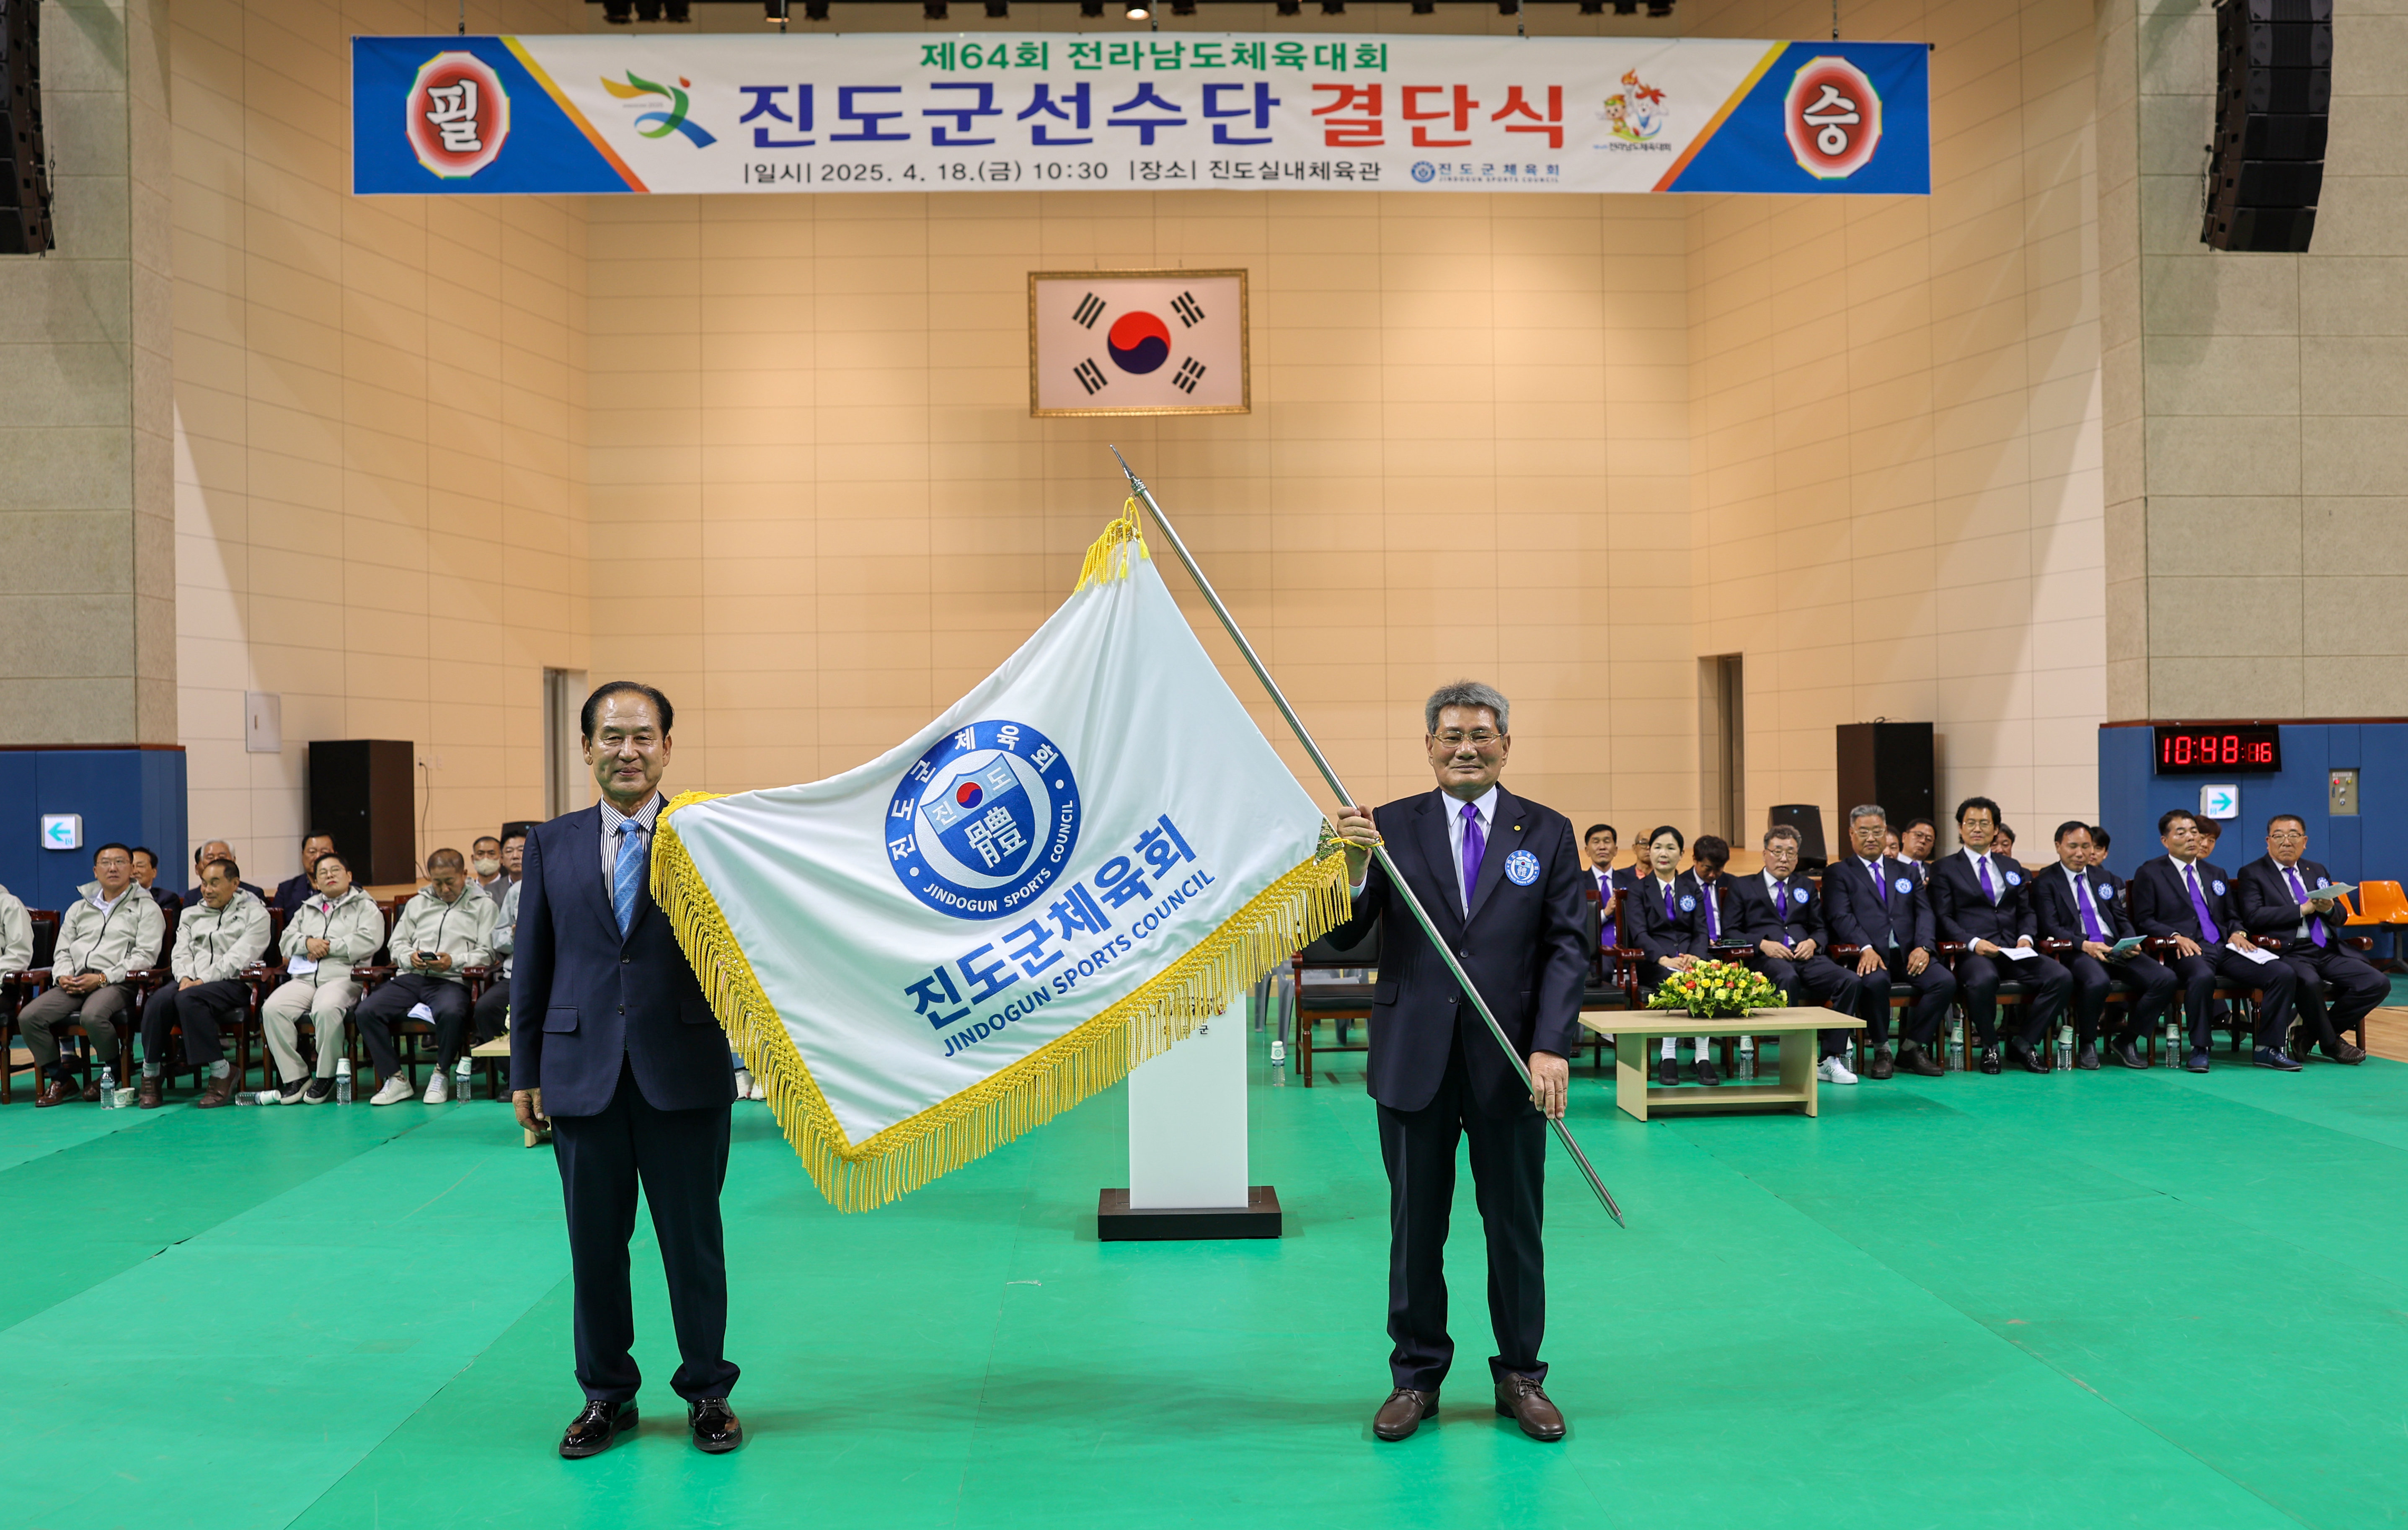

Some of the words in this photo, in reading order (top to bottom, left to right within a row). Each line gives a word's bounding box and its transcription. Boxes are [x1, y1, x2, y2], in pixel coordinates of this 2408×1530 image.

[921, 41, 1048, 71] 제64회
[1068, 41, 1387, 72] 전라남도체육대회
[426, 78, 482, 152] 필
[739, 83, 1281, 148] 진도군선수단
[1311, 83, 1564, 149] 결단식
[1802, 83, 1860, 156] 승
[821, 163, 892, 181] 2025.
[903, 164, 925, 181] 4.
[938, 161, 1021, 181] 18.(금)
[1034, 162, 1108, 180] 10:30
[1209, 160, 1381, 181] 진도실내체육관
[923, 883, 997, 912] JINDOGUN
[1004, 867, 1051, 907] SPORTS
[1050, 800, 1073, 863] COUNCIL
[964, 806, 1027, 868] 體
[904, 813, 1196, 1031] 진도군체육회
[944, 985, 1052, 1057] JINDOGUN
[1052, 933, 1132, 995] SPORTS
[1131, 868, 1216, 940] COUNCIL
